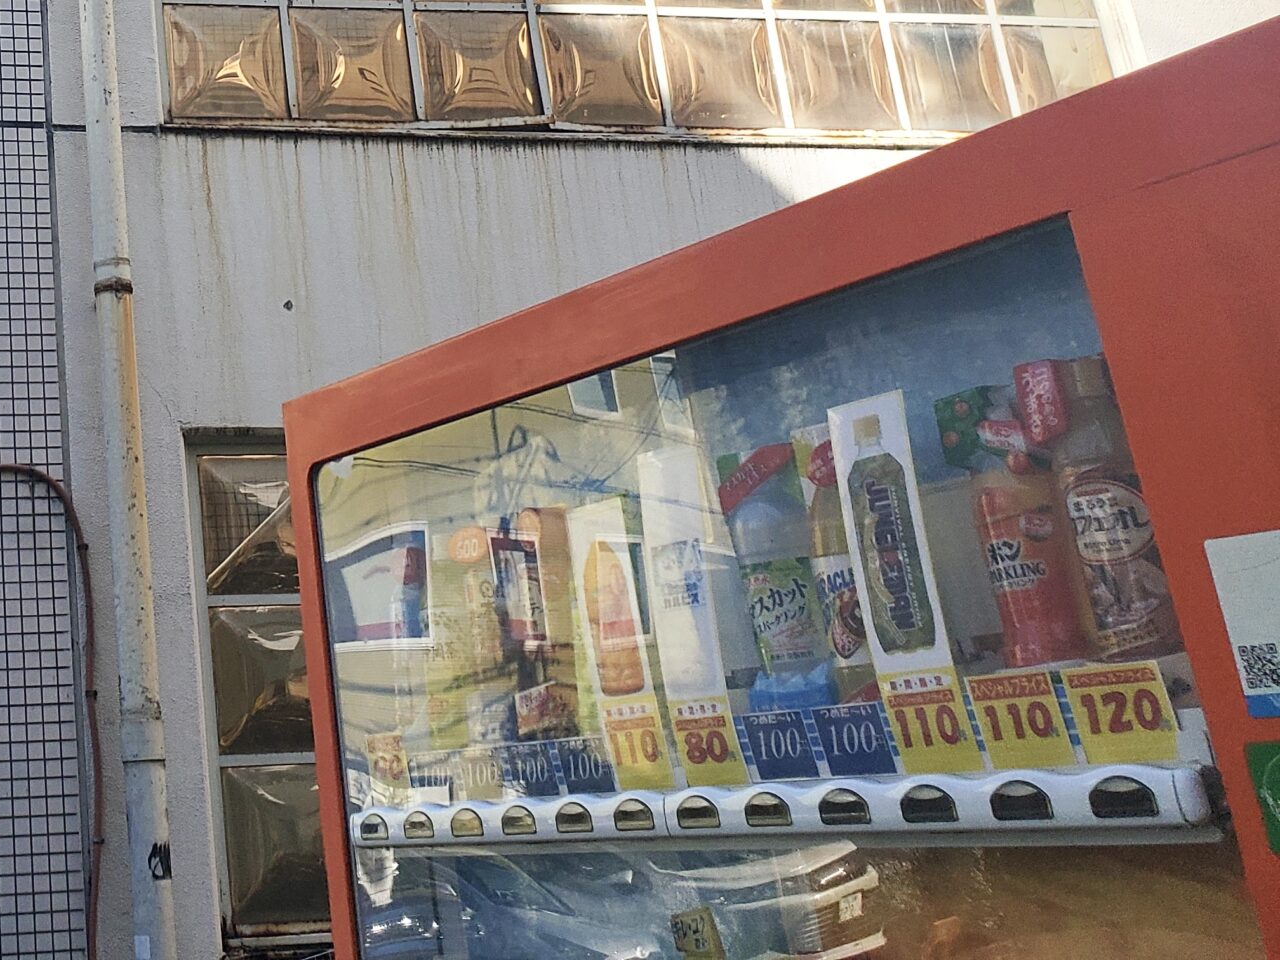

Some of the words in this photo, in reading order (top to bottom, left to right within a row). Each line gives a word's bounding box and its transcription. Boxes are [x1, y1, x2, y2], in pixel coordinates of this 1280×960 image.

[895, 704, 960, 748] 110
[984, 701, 1054, 740] 110
[1080, 688, 1163, 734] 120
[610, 729, 659, 766] 110
[684, 730, 729, 764] 80
